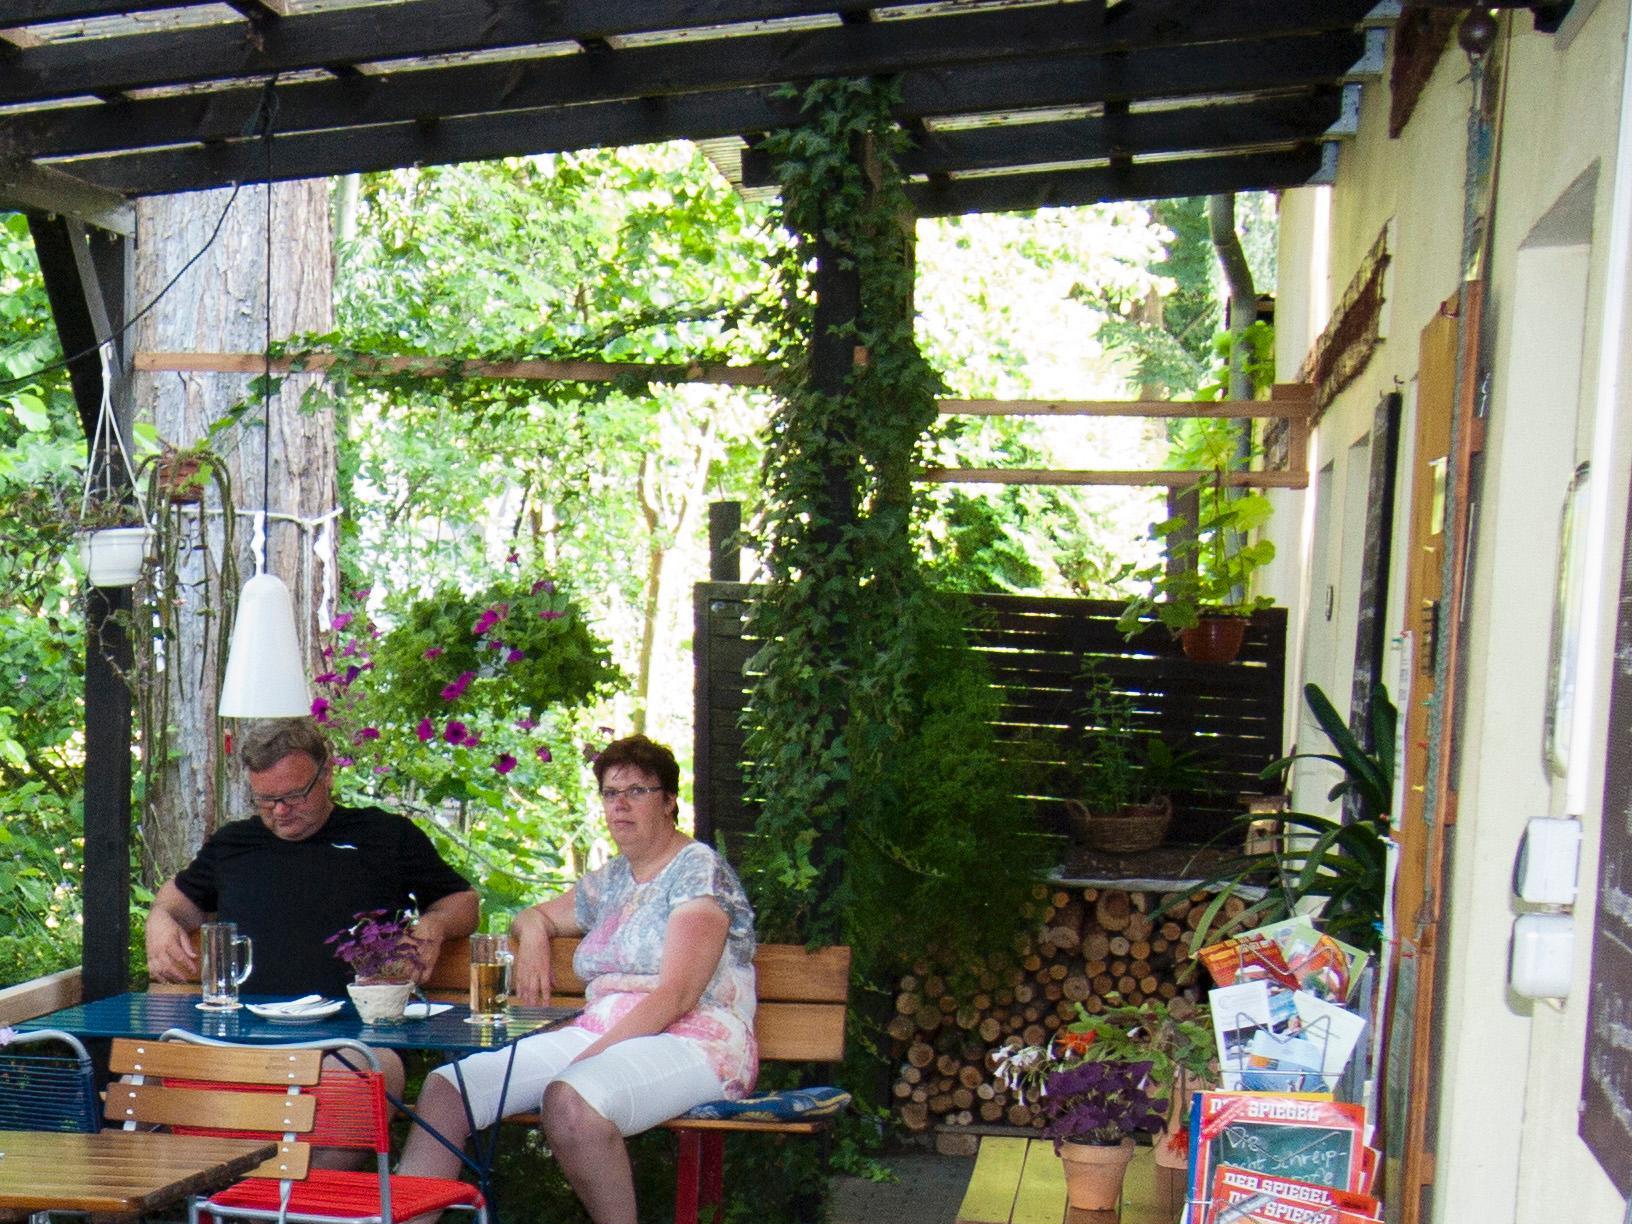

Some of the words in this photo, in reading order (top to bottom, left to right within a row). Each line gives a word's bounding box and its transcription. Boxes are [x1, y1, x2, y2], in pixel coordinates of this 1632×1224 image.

[1247, 1101, 1319, 1121] SPIEGEL
[1223, 1172, 1258, 1189] DER
[1261, 1180, 1332, 1205] SPIEGEL
